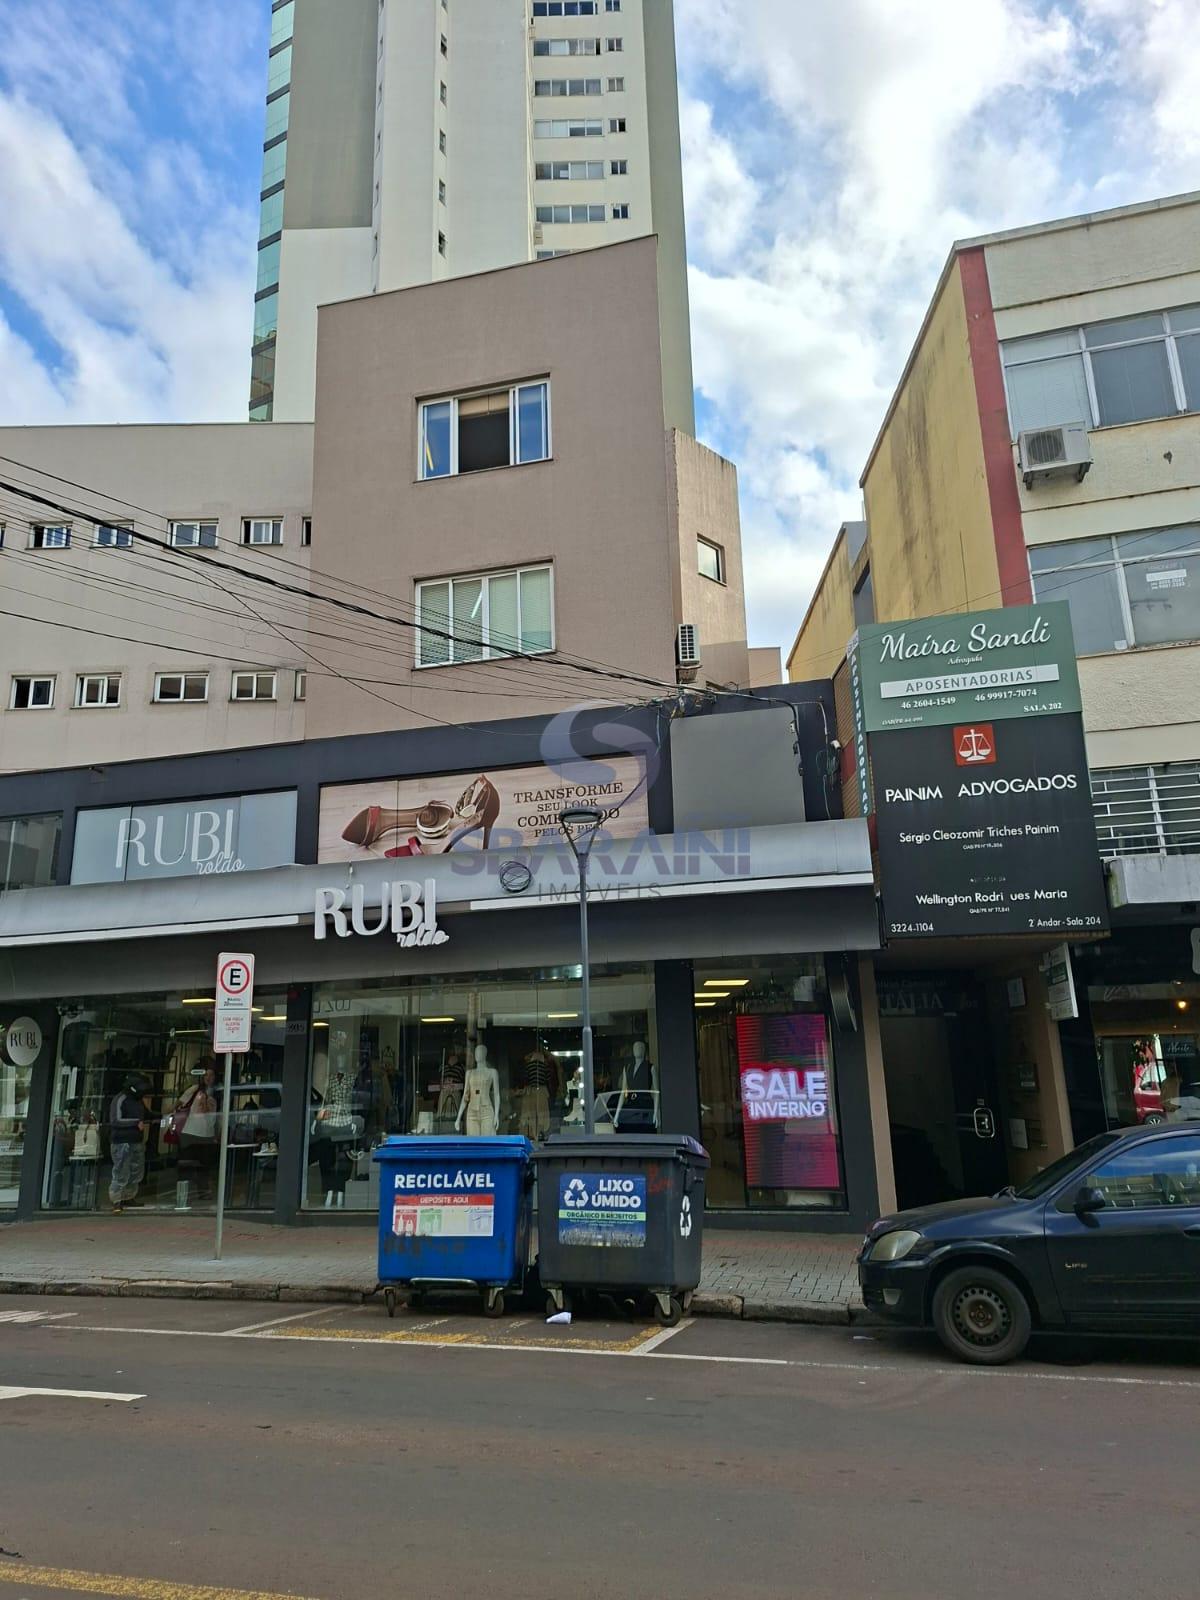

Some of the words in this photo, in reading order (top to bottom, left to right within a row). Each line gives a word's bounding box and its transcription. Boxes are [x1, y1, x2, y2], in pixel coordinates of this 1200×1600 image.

[879, 633, 960, 662] Maíra
[968, 616, 1052, 652] Sandi
[905, 669, 1033, 693] APOSENTADORIAS
[974, 693, 986, 702] 46
[987, 688, 1038, 700] 99917-7074
[900, 701, 912, 710] 46
[1023, 704, 1047, 713] SALA
[1048, 702, 1062, 711] 202
[514, 782, 623, 804] TRANSFORME
[885, 786, 943, 803] PAINIM
[957, 774, 1078, 797] ADVOGADOS
[537, 802, 560, 812] SEU
[564, 798, 598, 811] LOOK
[115, 808, 234, 868] RUBI
[932, 828, 985, 841] Cleozomir
[987, 825, 1023, 838] Triches
[1025, 823, 1060, 836] Painim
[916, 894, 973, 907] Wellington
[1034, 889, 1068, 900] Maria
[314, 878, 436, 940] RUBI
[1037, 917, 1061, 927] Andar
[1066, 916, 1083, 926] Sala
[1085, 916, 1101, 926] 204
[230, 968, 241, 986] E
[746, 1070, 827, 1101] SALE
[749, 1101, 825, 1118] INVERNO
[394, 1170, 495, 1189] RECICLÁVEL
[599, 1179, 634, 1193] LIXO
[591, 1191, 642, 1208] ÚMIDO
